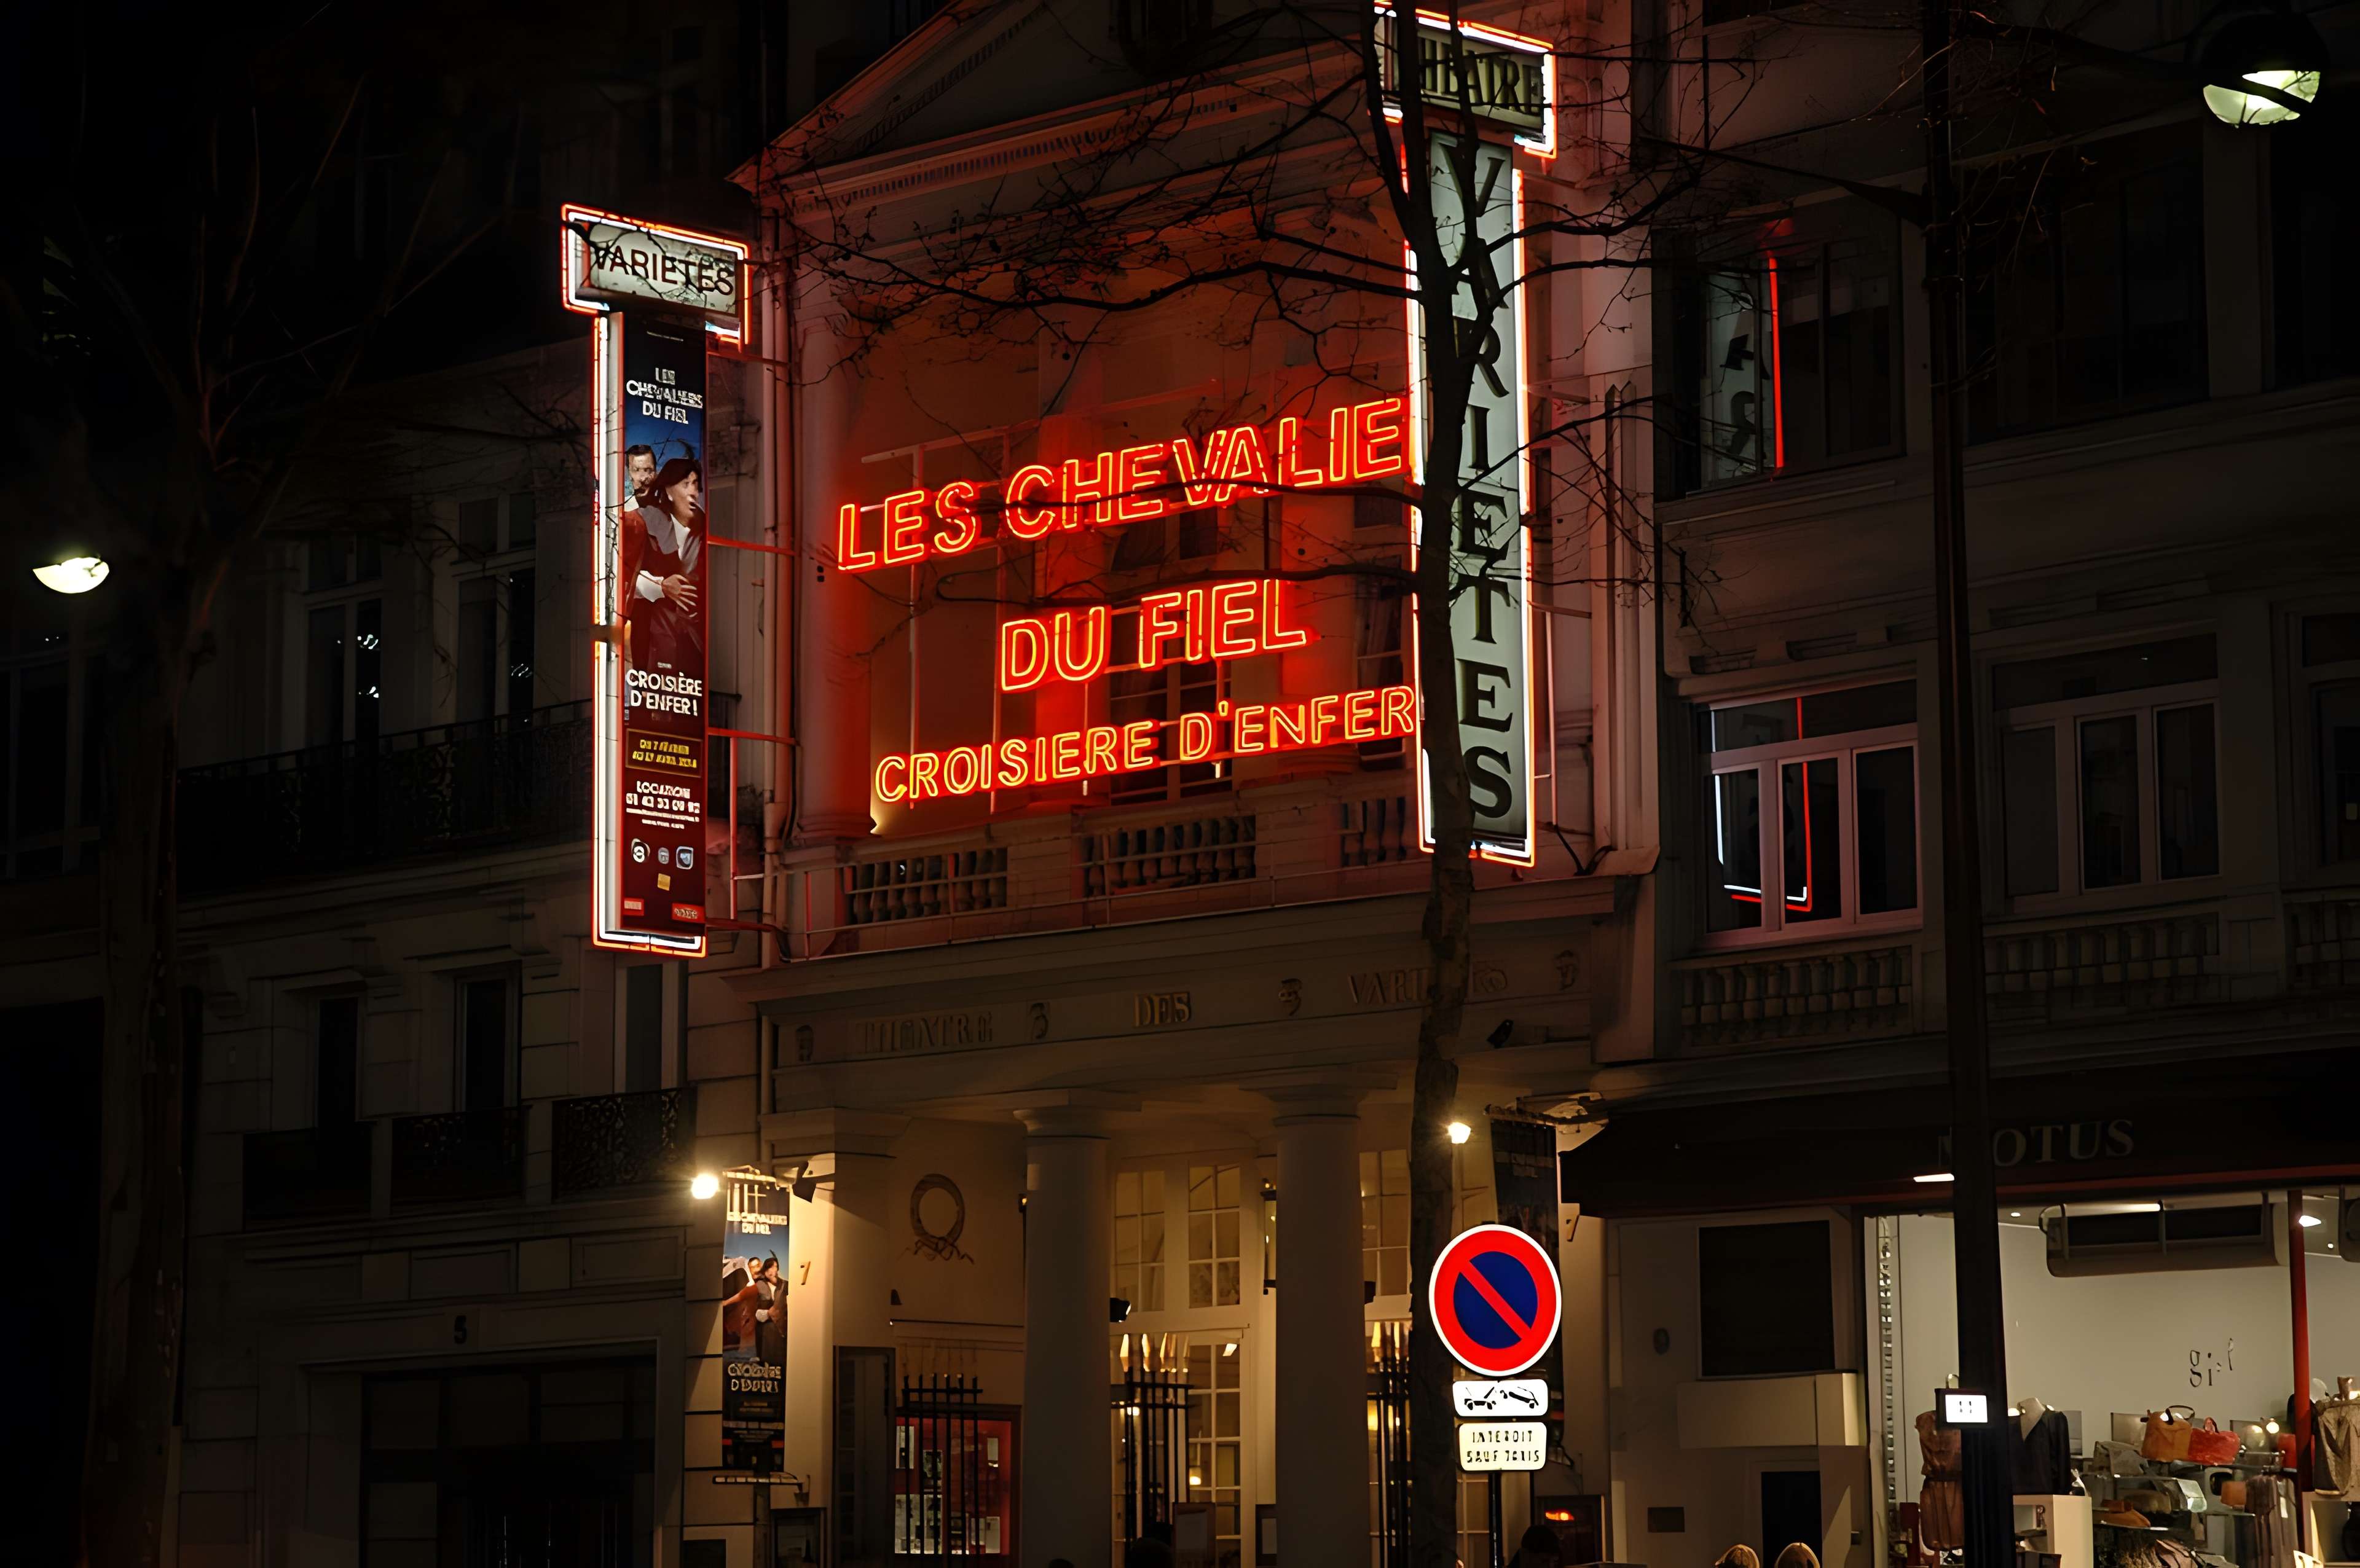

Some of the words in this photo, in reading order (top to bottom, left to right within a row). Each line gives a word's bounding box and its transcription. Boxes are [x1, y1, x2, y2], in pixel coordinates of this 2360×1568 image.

[642, 401, 662, 418] DU
[837, 482, 978, 571] LES
[1002, 606, 1106, 692] DU
[1138, 578, 1307, 668] FIEL
[875, 719, 1155, 803] CROISIERE
[1179, 684, 1415, 763] D'ENFER
